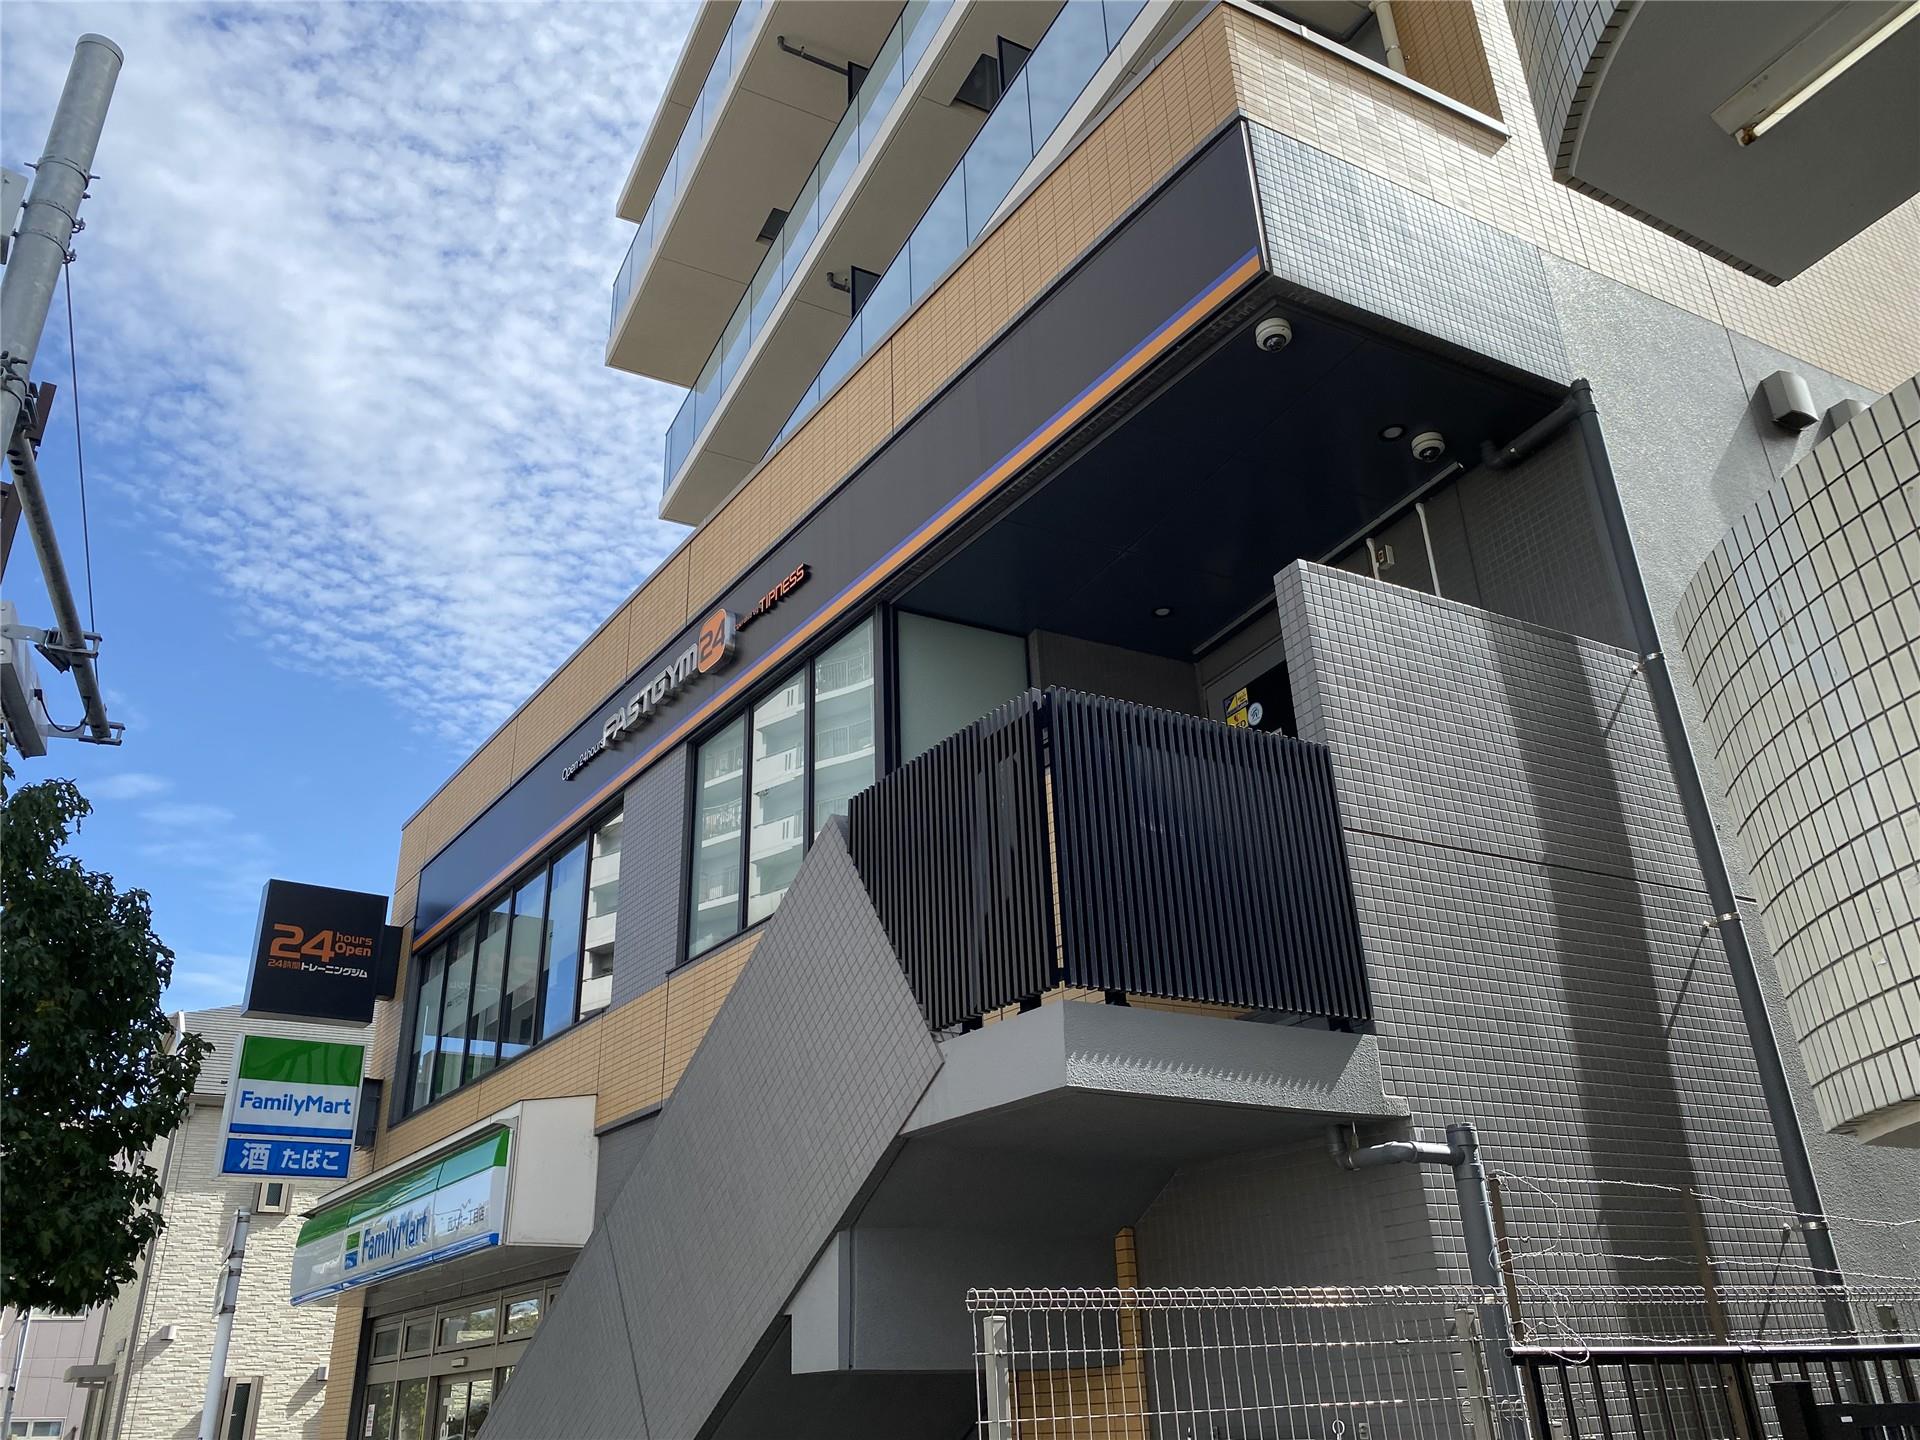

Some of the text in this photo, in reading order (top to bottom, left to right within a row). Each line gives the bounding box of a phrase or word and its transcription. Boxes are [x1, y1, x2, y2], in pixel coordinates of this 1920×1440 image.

[758, 563, 805, 613] TIPNESS
[269, 923, 374, 963] 24 hours
[334, 942, 372, 957] Open
[240, 1090, 351, 1116] FamilyMart
[240, 1142, 340, 1171] 酒 たばこ
[361, 1214, 427, 1264] FamilyMart
